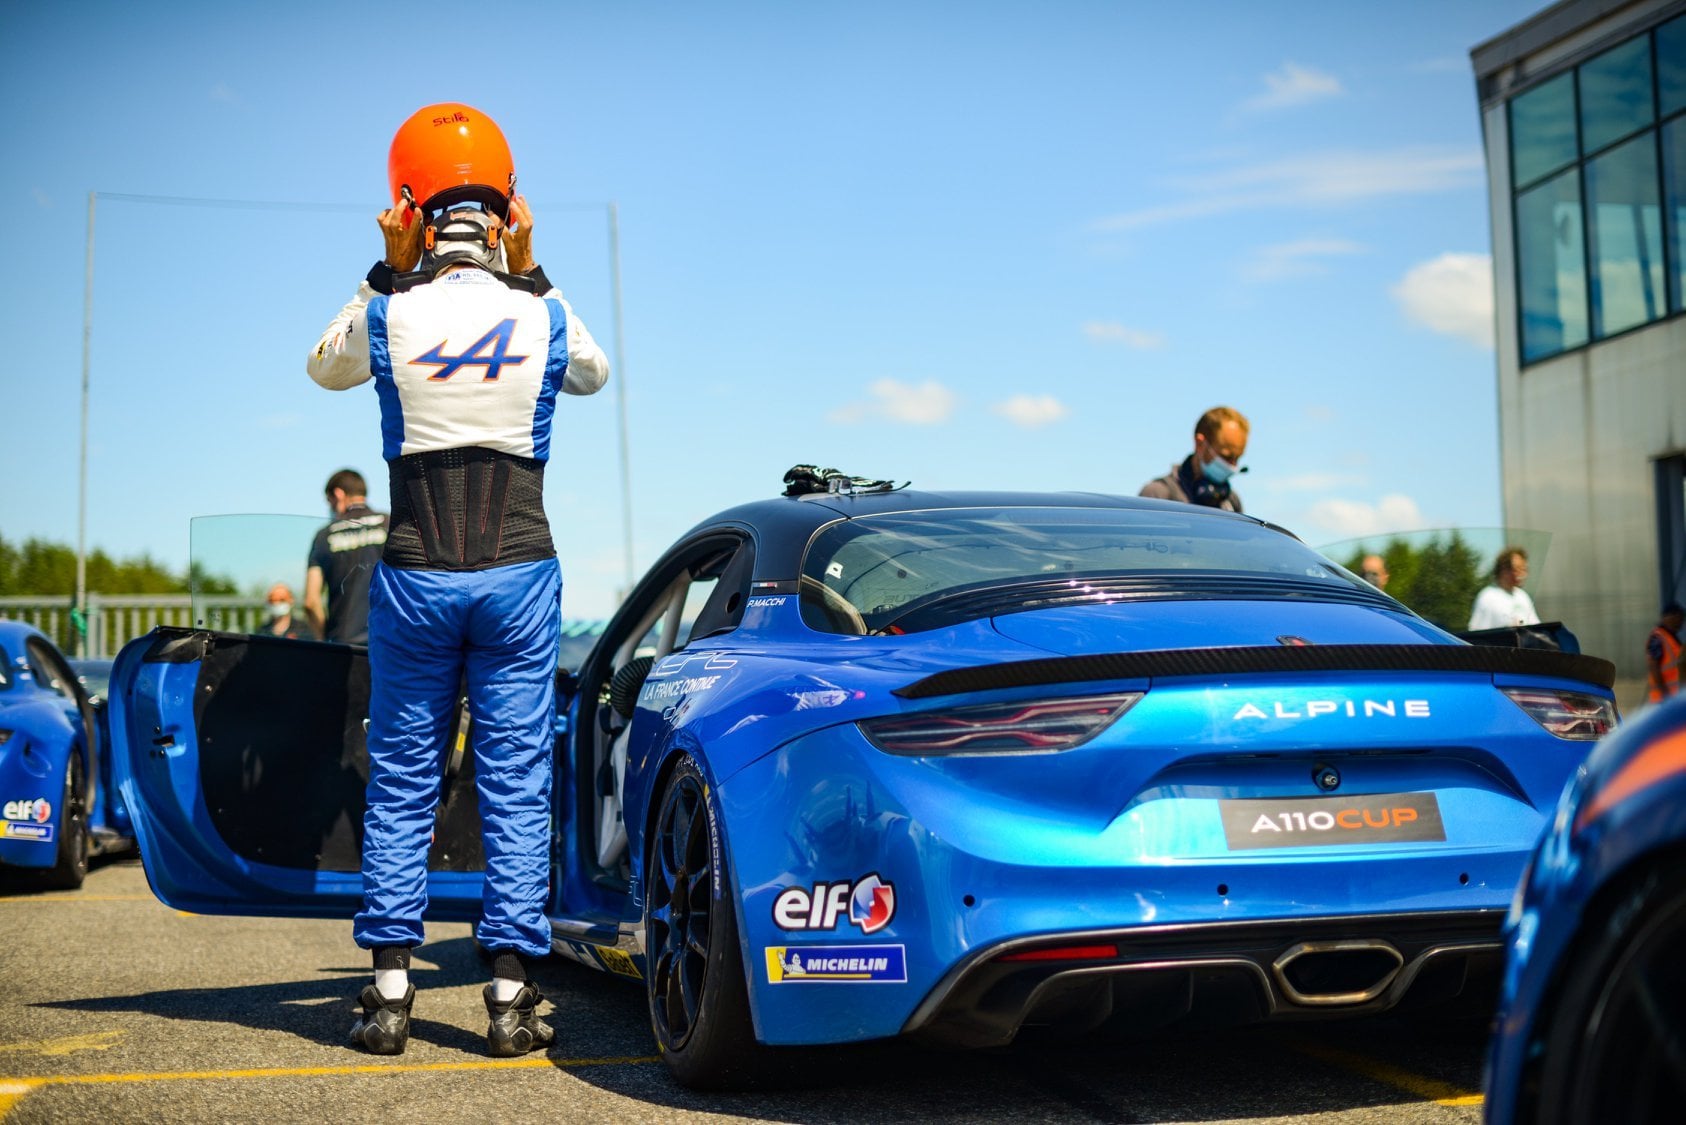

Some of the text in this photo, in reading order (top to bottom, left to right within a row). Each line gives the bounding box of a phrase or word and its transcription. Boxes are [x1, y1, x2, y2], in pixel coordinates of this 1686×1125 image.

[1233, 699, 1431, 720] ALPINE
[3, 800, 34, 820] elf
[774, 884, 849, 929] elf
[806, 957, 888, 971] MICHELIN
